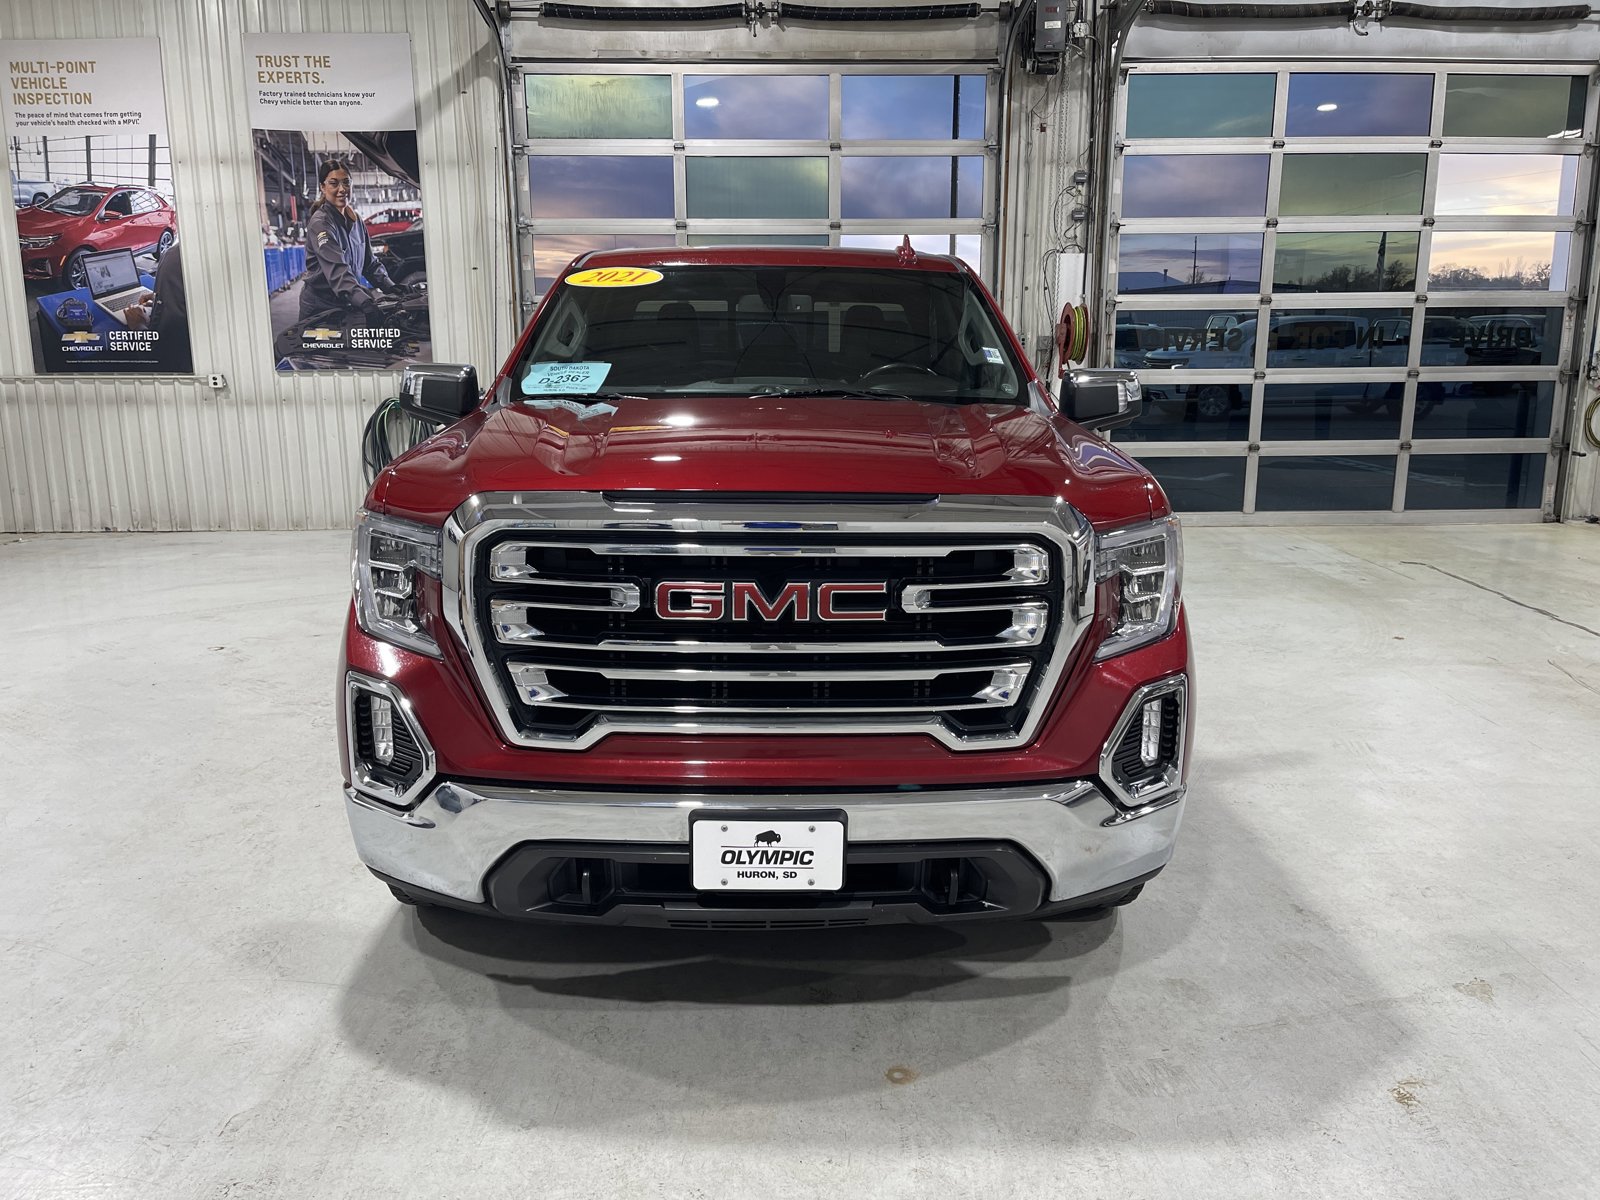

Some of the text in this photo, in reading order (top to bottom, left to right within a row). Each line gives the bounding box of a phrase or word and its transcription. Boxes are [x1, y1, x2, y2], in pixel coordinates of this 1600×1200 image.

[256, 55, 331, 68] TRUST THE
[9, 61, 96, 74] MULTI-POINT
[257, 71, 325, 84] EXPERTS.
[11, 77, 67, 90] VEHICLE
[13, 92, 93, 105] INSPECTION
[258, 90, 283, 98] Factory
[259, 98, 279, 106] Chevy
[279, 98, 301, 106] vehicle
[27, 112, 46, 120] peace
[119, 110, 142, 119] getting
[581, 271, 649, 283] 2021
[108, 331, 160, 341] CERTIFIED
[349, 328, 400, 338] CERTIFIED
[110, 341, 152, 351] SERVICE
[351, 339, 393, 348] SERVICE
[538, 374, 591, 384] D-2367
[655, 581, 887, 621] GMC
[720, 850, 814, 865] OLYMPIC
[737, 871, 797, 880] HURON, SD
